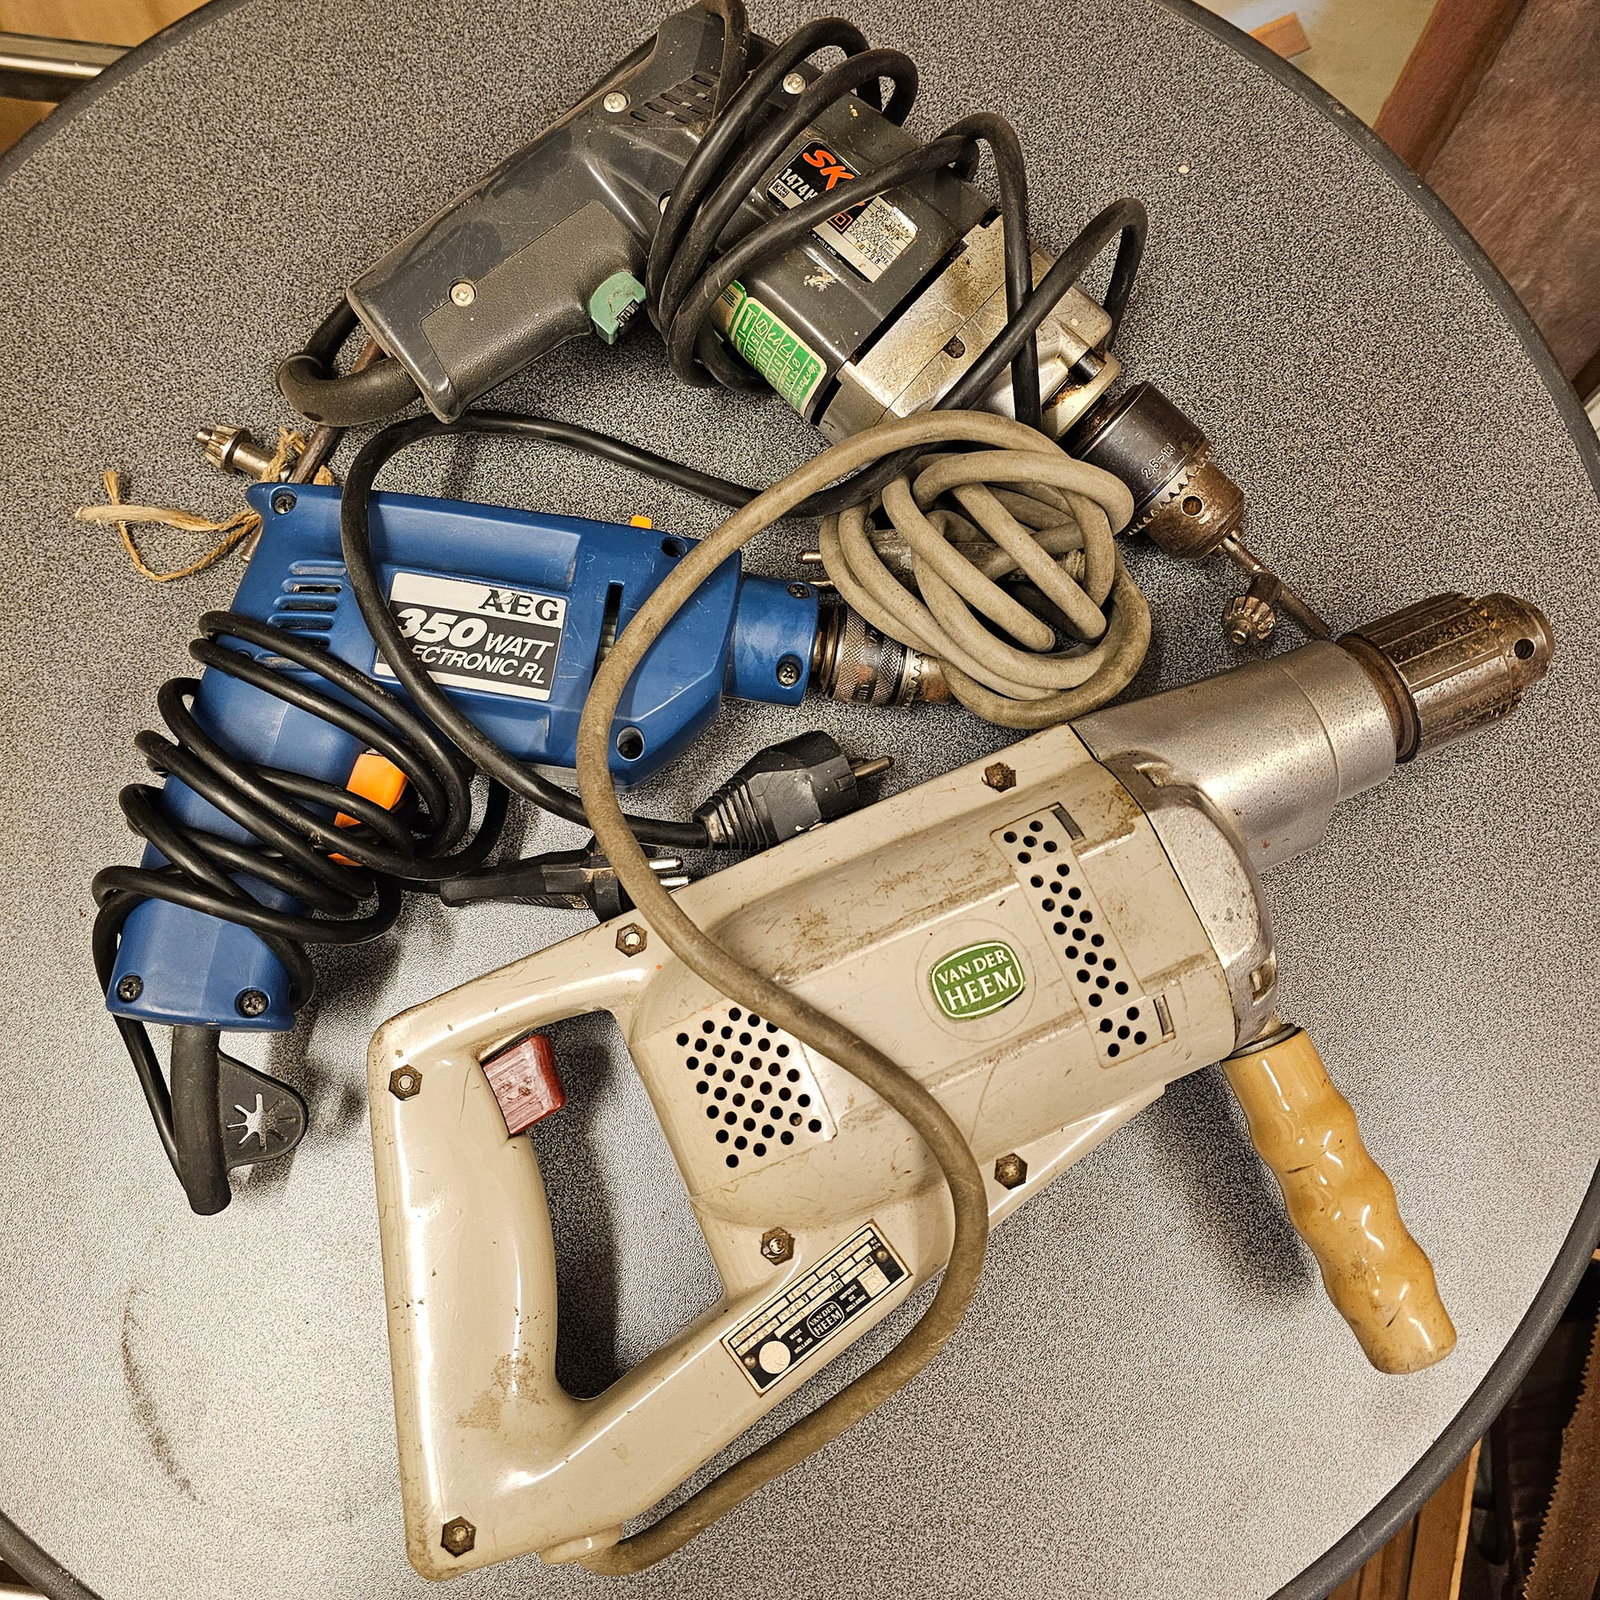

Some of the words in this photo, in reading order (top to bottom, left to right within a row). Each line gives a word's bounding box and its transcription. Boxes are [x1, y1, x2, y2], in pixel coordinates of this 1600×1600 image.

[803, 150, 856, 191] SK
[816, 237, 837, 255] HOLLAND
[478, 589, 559, 622] AEG
[397, 608, 488, 648] 350
[484, 632, 555, 661] WATT
[411, 644, 519, 676] ECTRONIC
[519, 662, 545, 684] RL
[937, 962, 972, 986] VAN
[972, 950, 1009, 973] DER
[944, 965, 1018, 1011] HEEM
[809, 1313, 823, 1326] VAN
[821, 1303, 837, 1317] DER
[813, 1310, 842, 1336] HEEM
